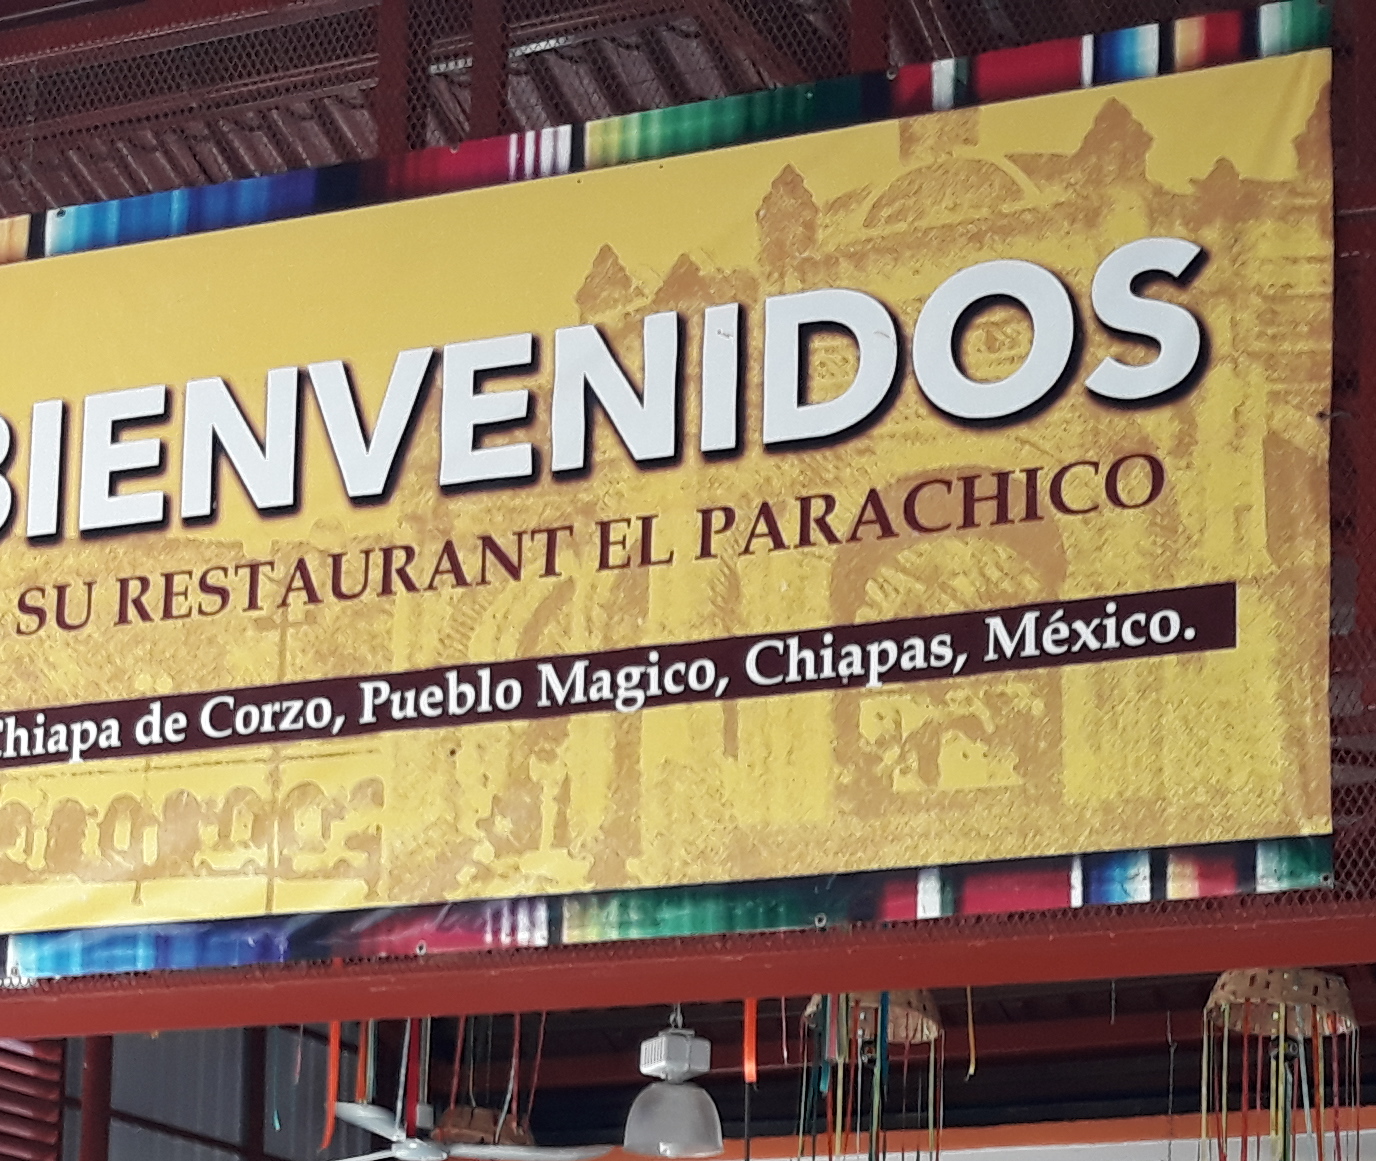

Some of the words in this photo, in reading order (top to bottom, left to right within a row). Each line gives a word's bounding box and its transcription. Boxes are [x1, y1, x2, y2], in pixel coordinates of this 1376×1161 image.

[15, 578, 95, 638] SU
[114, 523, 574, 631] RESTAURANT
[594, 514, 675, 571] EL
[693, 452, 1167, 562] PARACHICO
[142, 703, 187, 746] de
[199, 693, 346, 740] Corzo,
[359, 666, 523, 726] Pueblo
[536, 650, 730, 714] Magico,
[745, 625, 968, 692] Chiapas,
[982, 600, 1197, 664] México.
